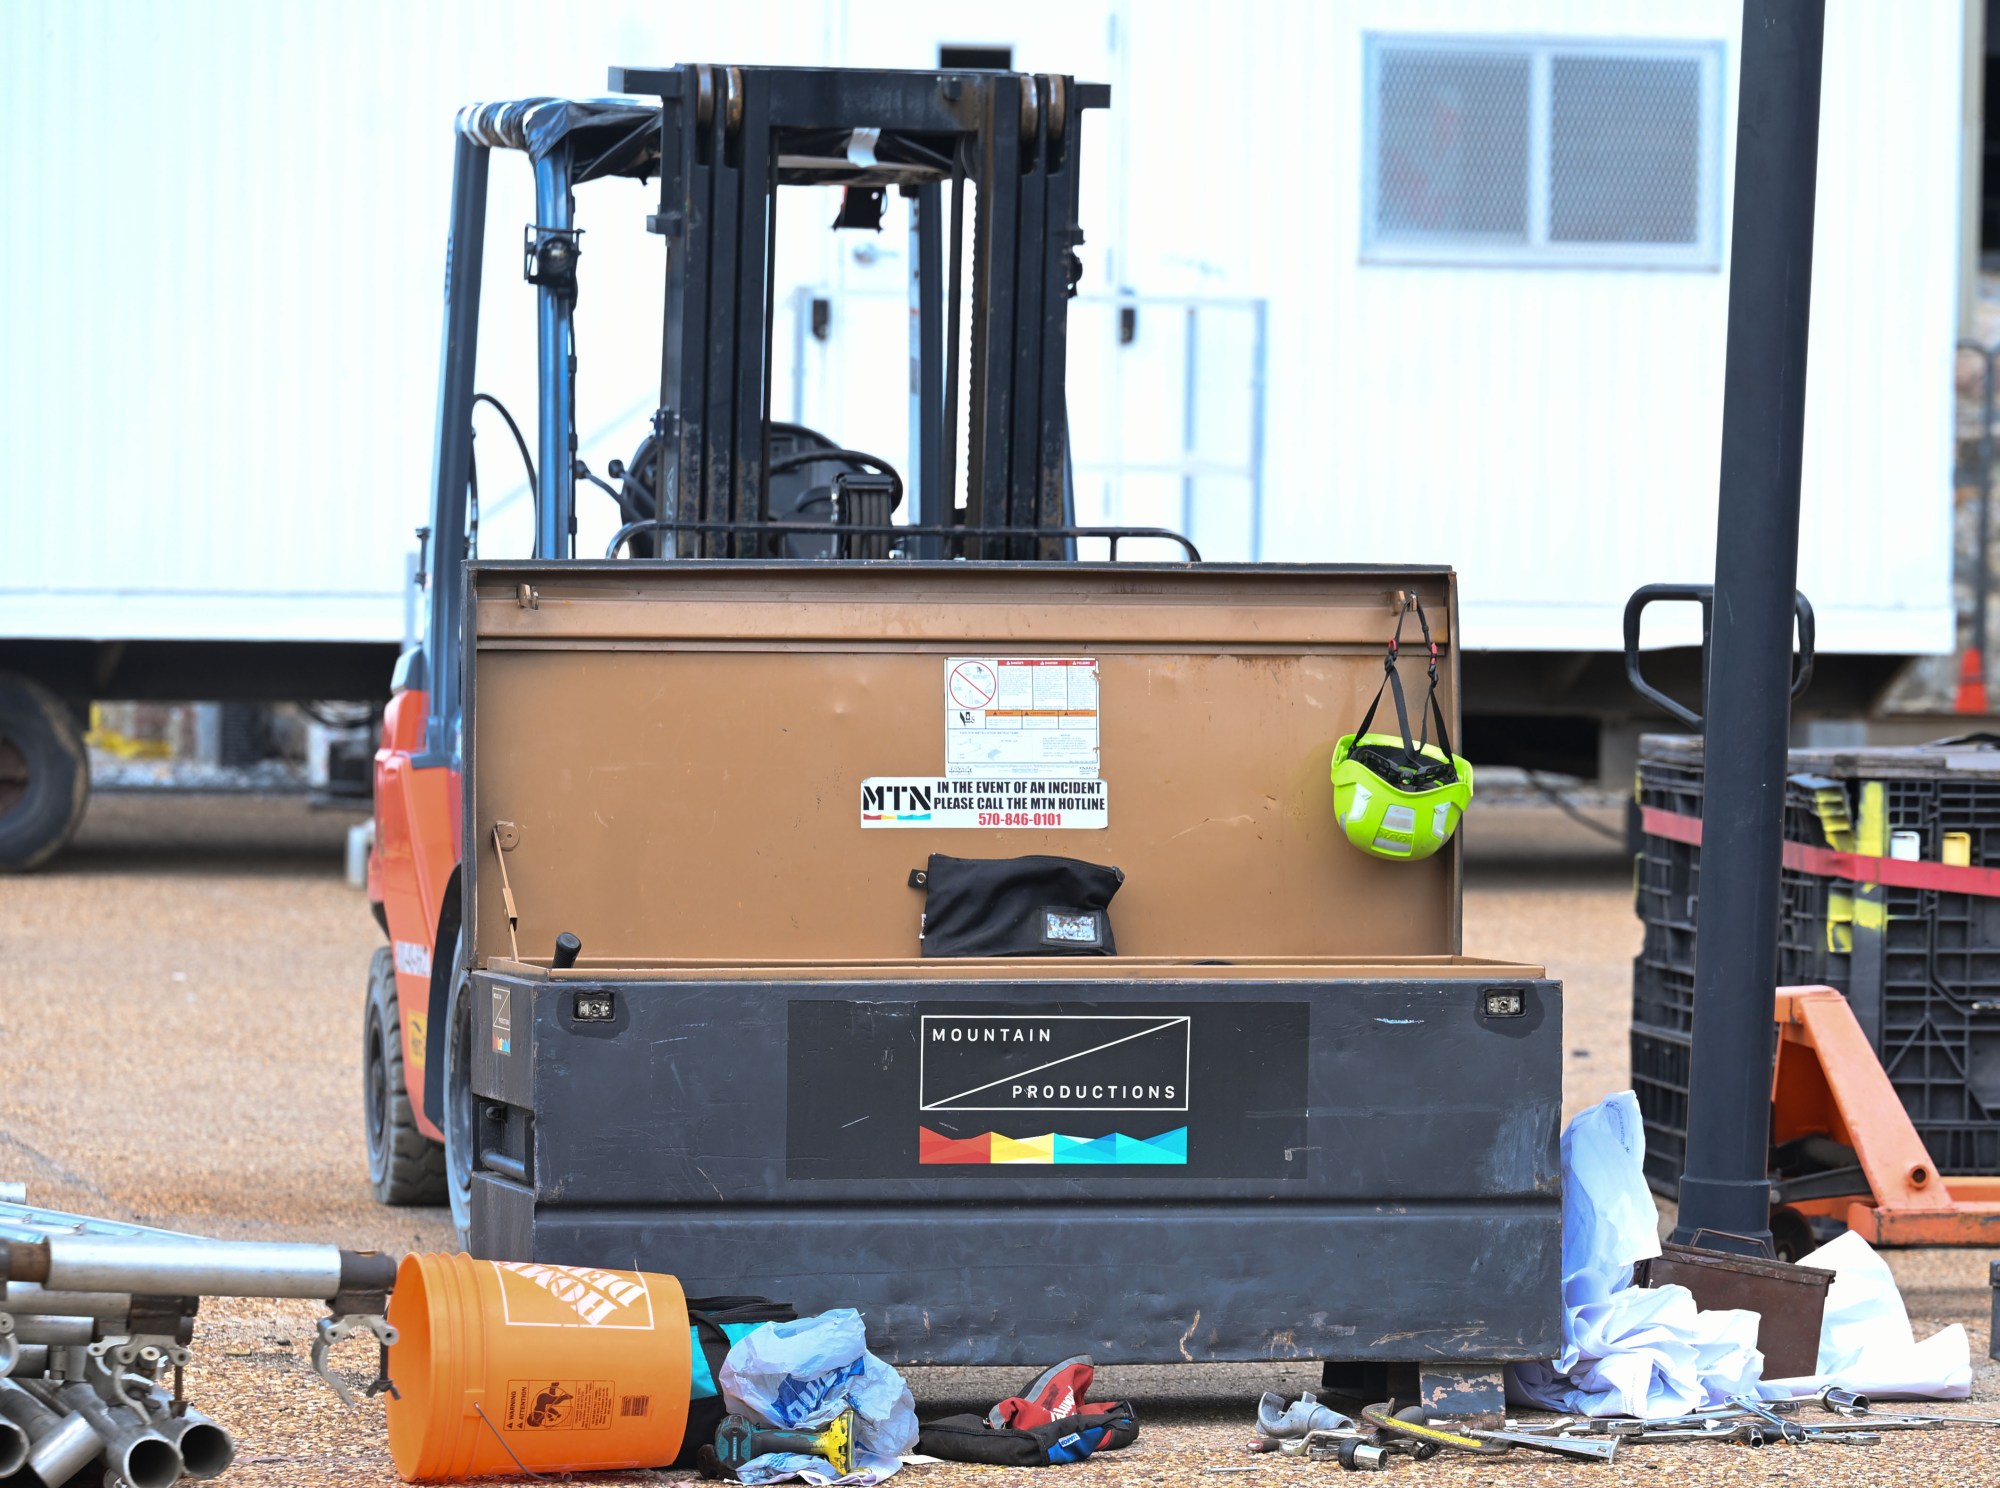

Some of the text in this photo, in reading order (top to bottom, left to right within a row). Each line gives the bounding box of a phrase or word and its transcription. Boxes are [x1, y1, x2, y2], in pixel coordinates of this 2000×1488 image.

[937, 781, 1102, 794] IN THE EVENT OF AN INCIDENT
[863, 786, 931, 811] MTN
[934, 797, 1105, 810] PLEASE CALL THE MTN HOTLINE
[978, 813, 1062, 826] 570-846-0101
[932, 1028, 1051, 1042] MOUNTAIN
[1012, 1085, 1176, 1099] PRODUCTIONS
[508, 1391, 517, 1420] WARNING
[519, 1386, 527, 1420] ATTENTION
